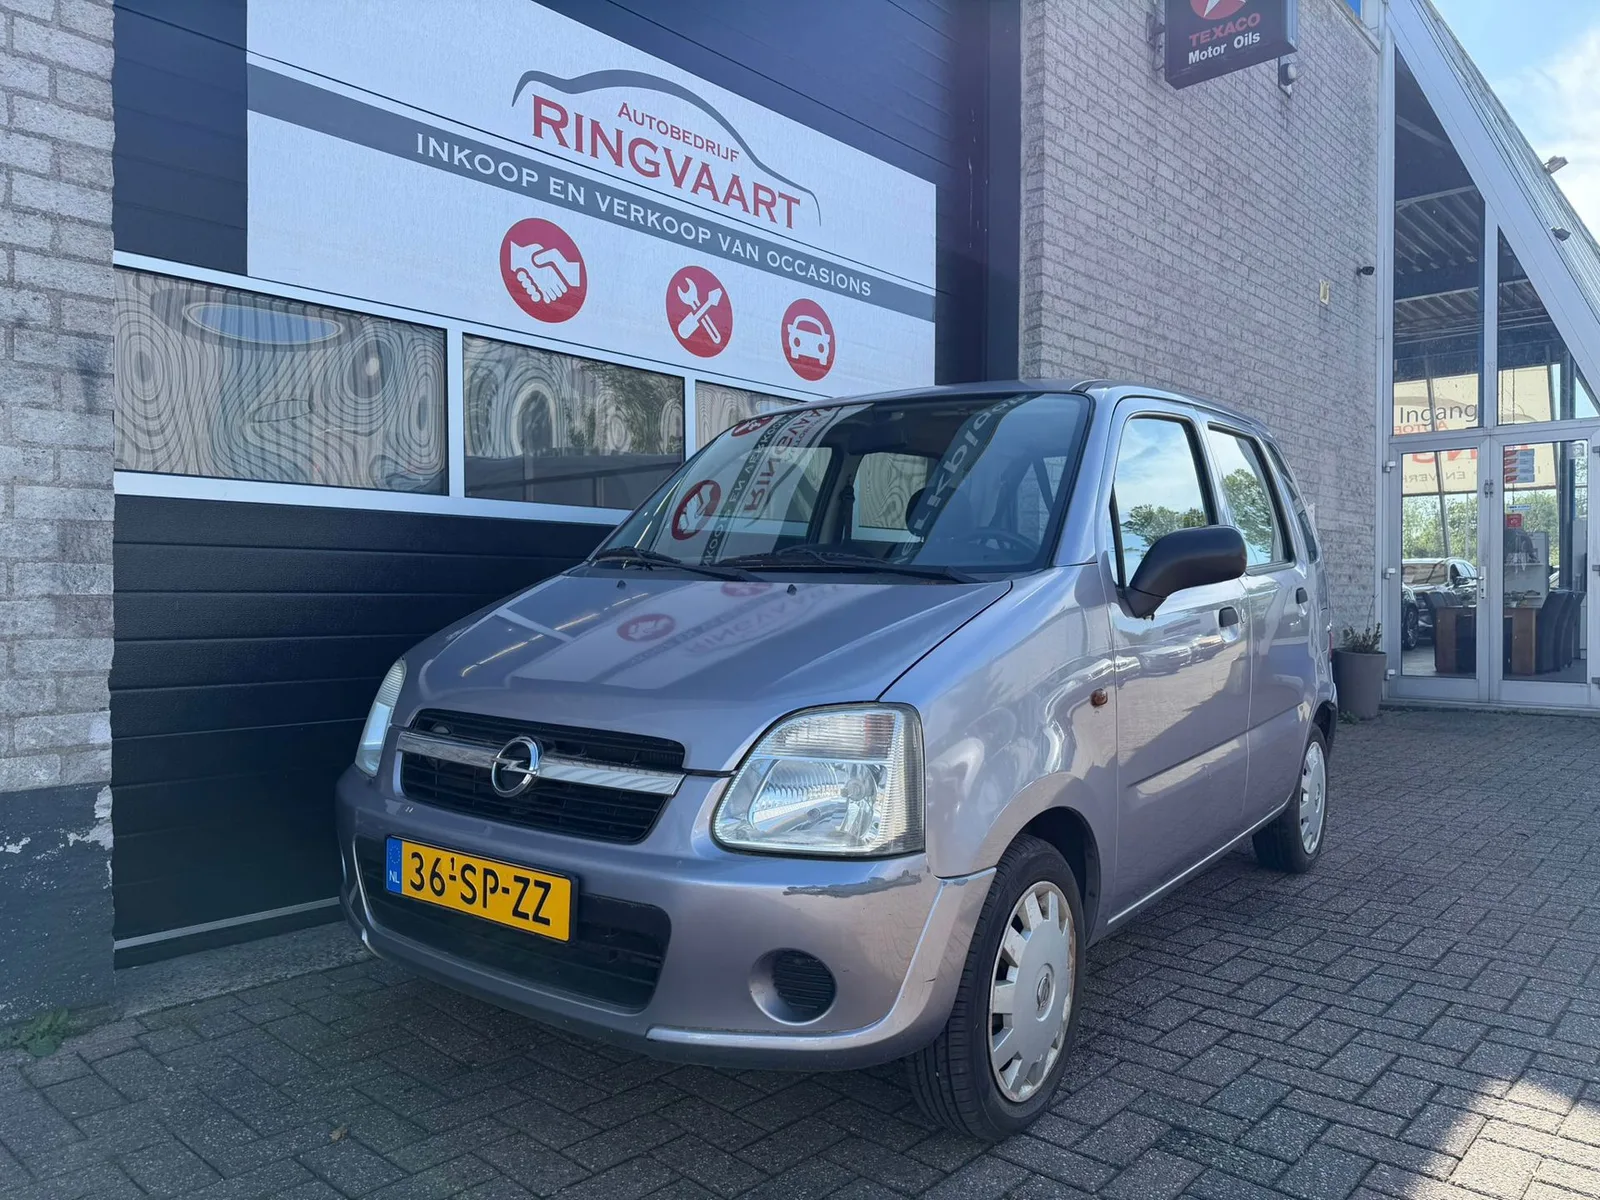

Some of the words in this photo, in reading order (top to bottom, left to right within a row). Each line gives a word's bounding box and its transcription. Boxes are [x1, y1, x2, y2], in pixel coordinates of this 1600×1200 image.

[1188, 13, 1261, 47] TEXACO
[1188, 43, 1227, 65] Motor
[1233, 32, 1261, 49] Oils
[617, 102, 740, 162] AUTOBEDRIJF
[532, 94, 800, 229] RINGVAART
[416, 133, 539, 187] INKOOP
[549, 176, 585, 206] EN
[595, 191, 711, 244] VERKOOP
[718, 233, 759, 262] VAN
[766, 251, 871, 296] OCCASIONS
[1400, 404, 1478, 427] Ingang
[388, 870, 400, 884] NL
